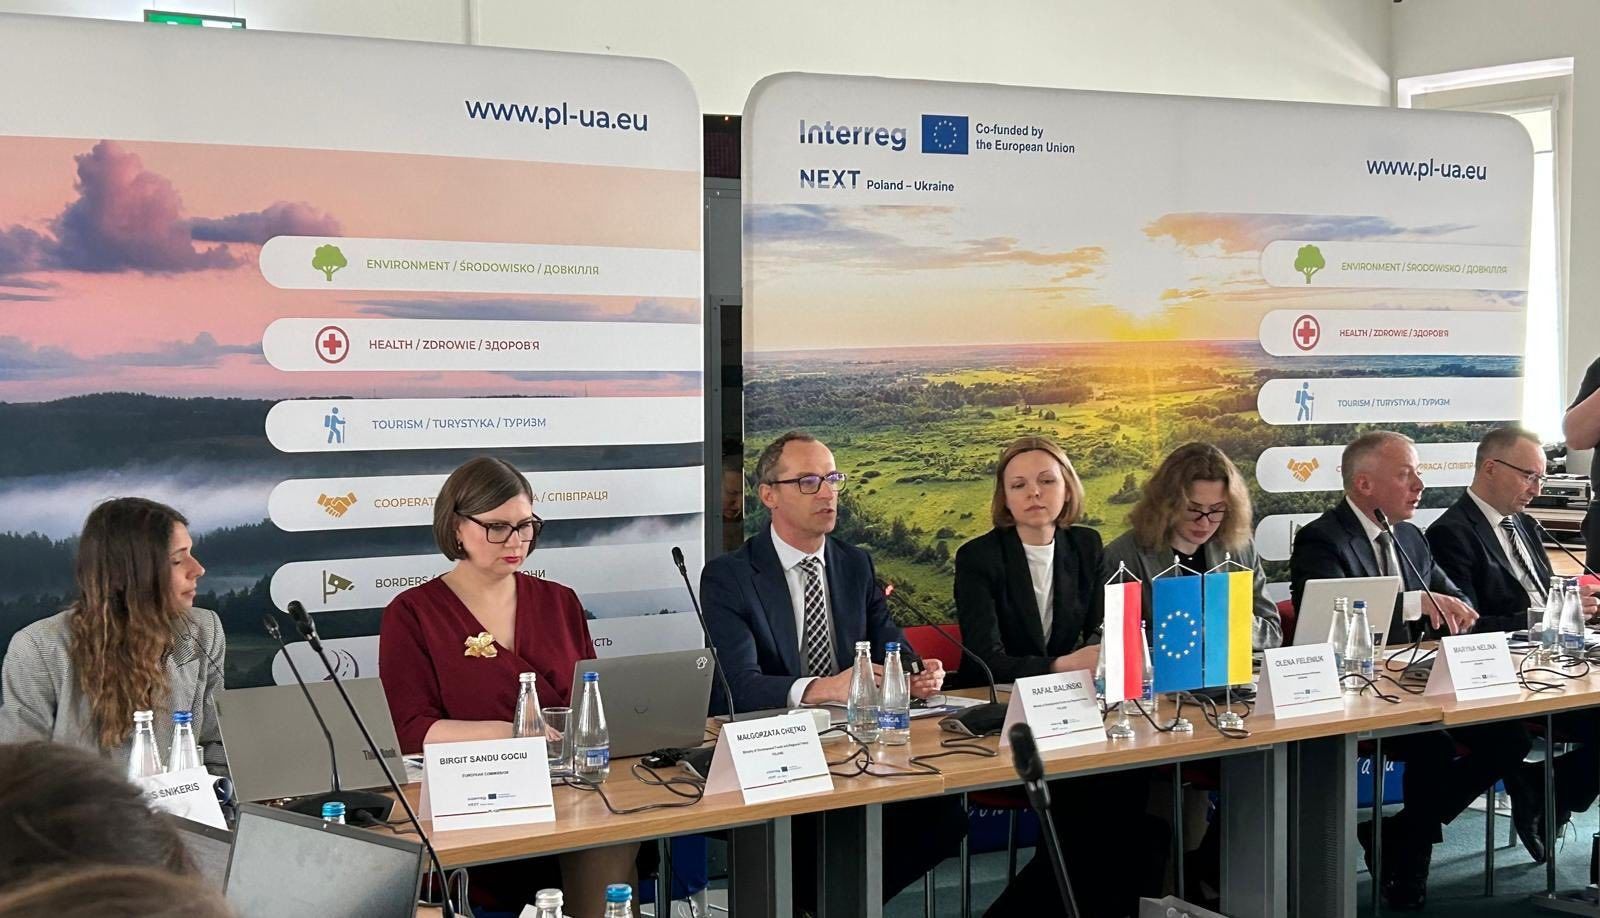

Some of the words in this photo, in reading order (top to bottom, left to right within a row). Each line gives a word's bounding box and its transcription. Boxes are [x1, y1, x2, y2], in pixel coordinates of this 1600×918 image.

[464, 100, 648, 132] www.pl-ua.eu
[800, 119, 907, 151] Interreg
[976, 123, 1029, 136] Co-funded
[1031, 126, 1044, 139] by
[976, 139, 993, 150] the
[995, 139, 1043, 153] European
[1046, 142, 1075, 154] Union
[1367, 158, 1487, 181] www.pl-ua.eu
[800, 169, 861, 190] NEXT
[866, 179, 904, 191] Poland
[914, 180, 955, 192] Ukraine
[366, 259, 451, 271] ENVIRONMENT
[459, 259, 535, 274] ŚRODOWISKO
[543, 264, 599, 276] ДОВКІЛЛЯ
[1341, 261, 1401, 273] ENVIRONMENT
[1339, 329, 1368, 337] HEALTH
[1374, 329, 1408, 337] ZDROWIE
[369, 339, 413, 350] HEALTH
[422, 339, 476, 350] ZDROWIE
[1337, 399, 1371, 407] TOURISM
[371, 419, 424, 430] TOURISM
[432, 418, 495, 429] TURYSTYKA
[503, 417, 546, 429] ТУРИЗМ
[374, 497, 435, 509] COOPERAT
[548, 490, 609, 503] СПІВПРАЦЯ
[375, 576, 428, 588] BORDERS
[439, 756, 468, 765] BIRGIT
[469, 754, 499, 763] SANDU
[500, 752, 528, 761] GOCIU
[159, 782, 200, 798] SNIKERIS
